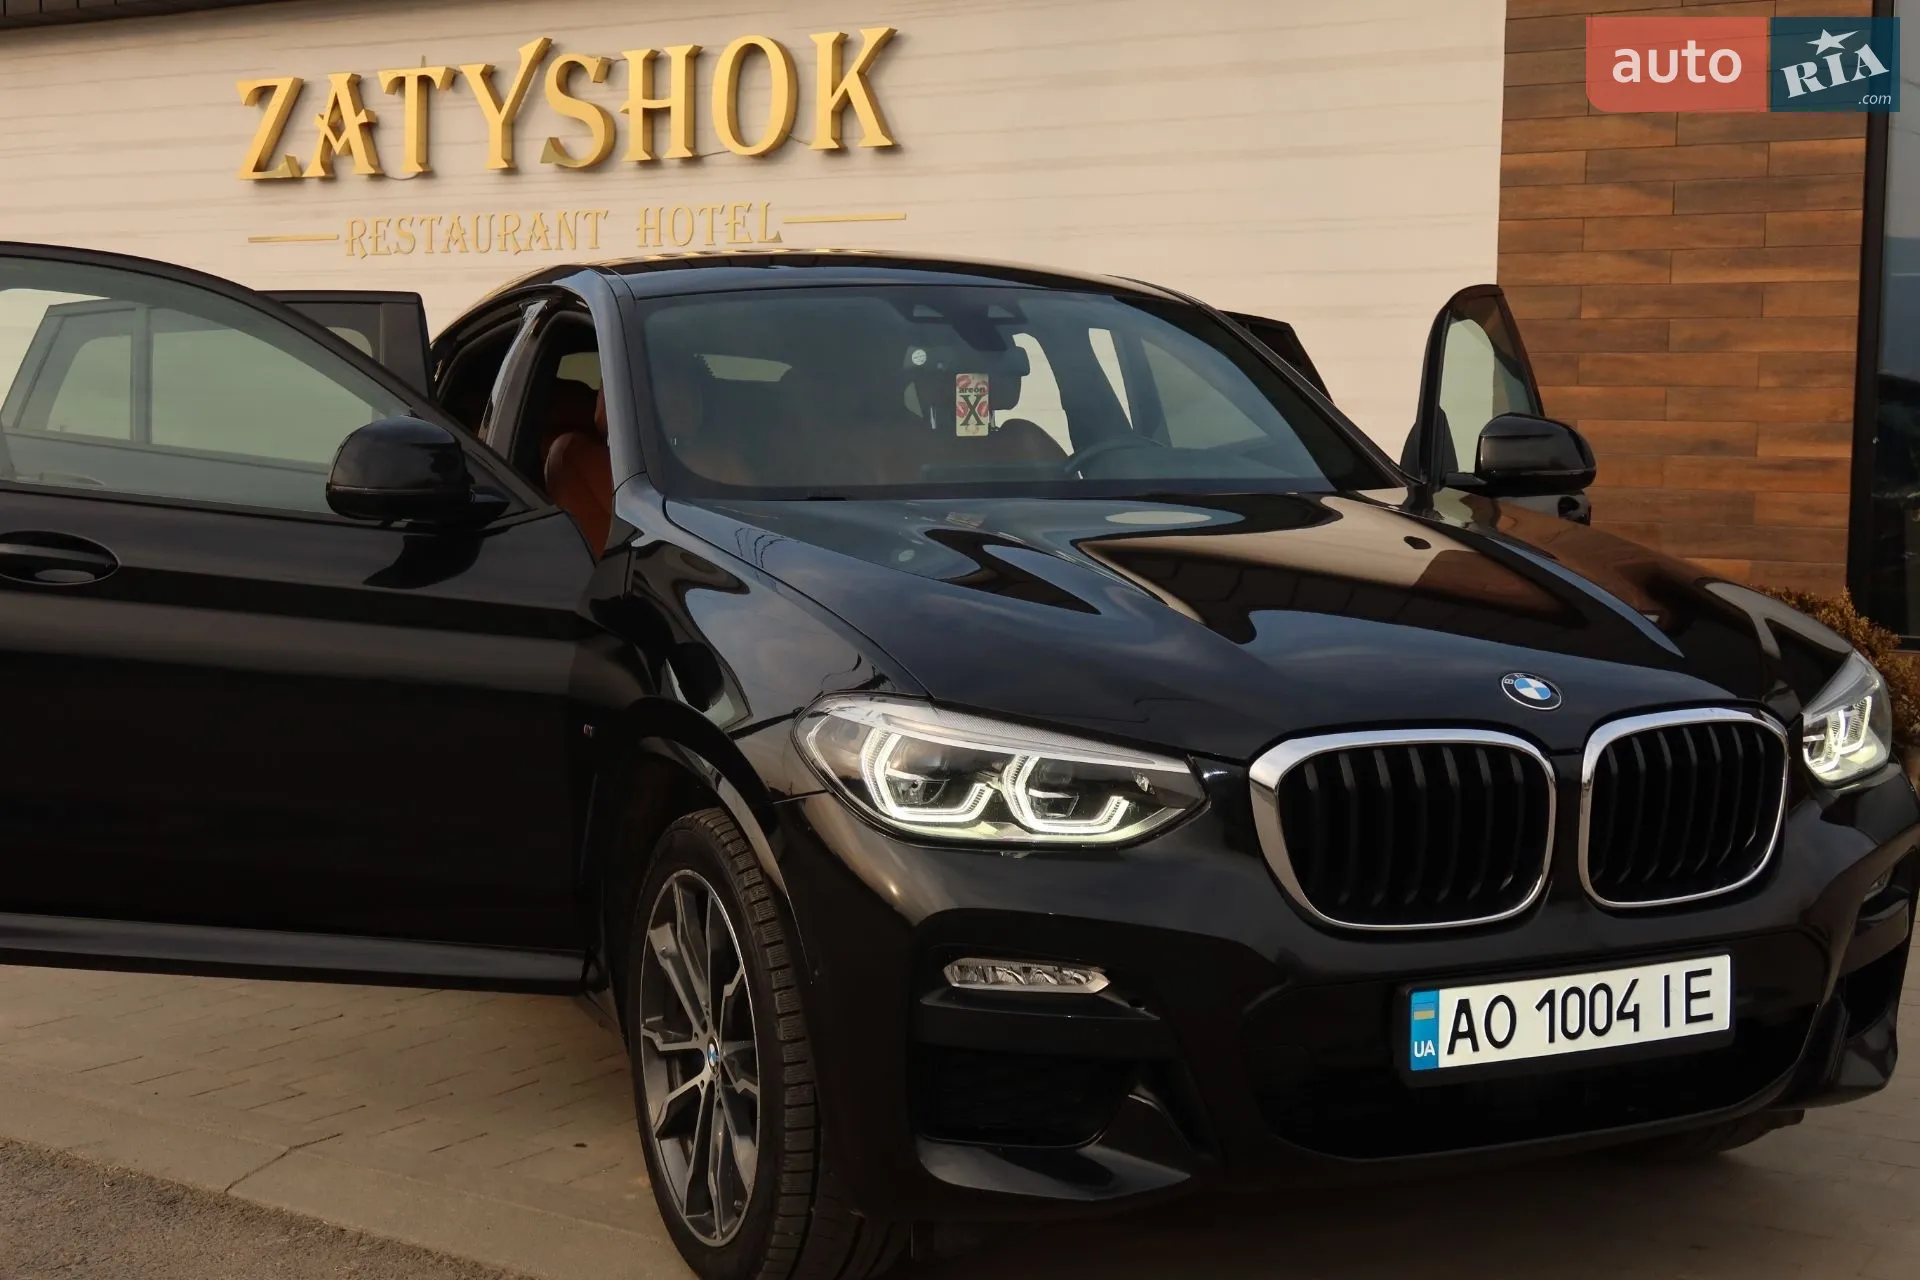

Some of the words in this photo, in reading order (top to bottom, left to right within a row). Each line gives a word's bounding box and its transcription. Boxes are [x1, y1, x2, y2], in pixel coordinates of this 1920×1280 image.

[236, 27, 898, 180] ZATYSHOK
[345, 209, 609, 259] RESTAURANT
[636, 202, 782, 248] HOTEL
[958, 386, 986, 394] areon
[959, 394, 985, 426] X
[1447, 994, 1517, 1055] AO
[1535, 978, 1640, 1044] 1004
[1663, 968, 1714, 1028] IE
[1413, 1040, 1436, 1058] UA
